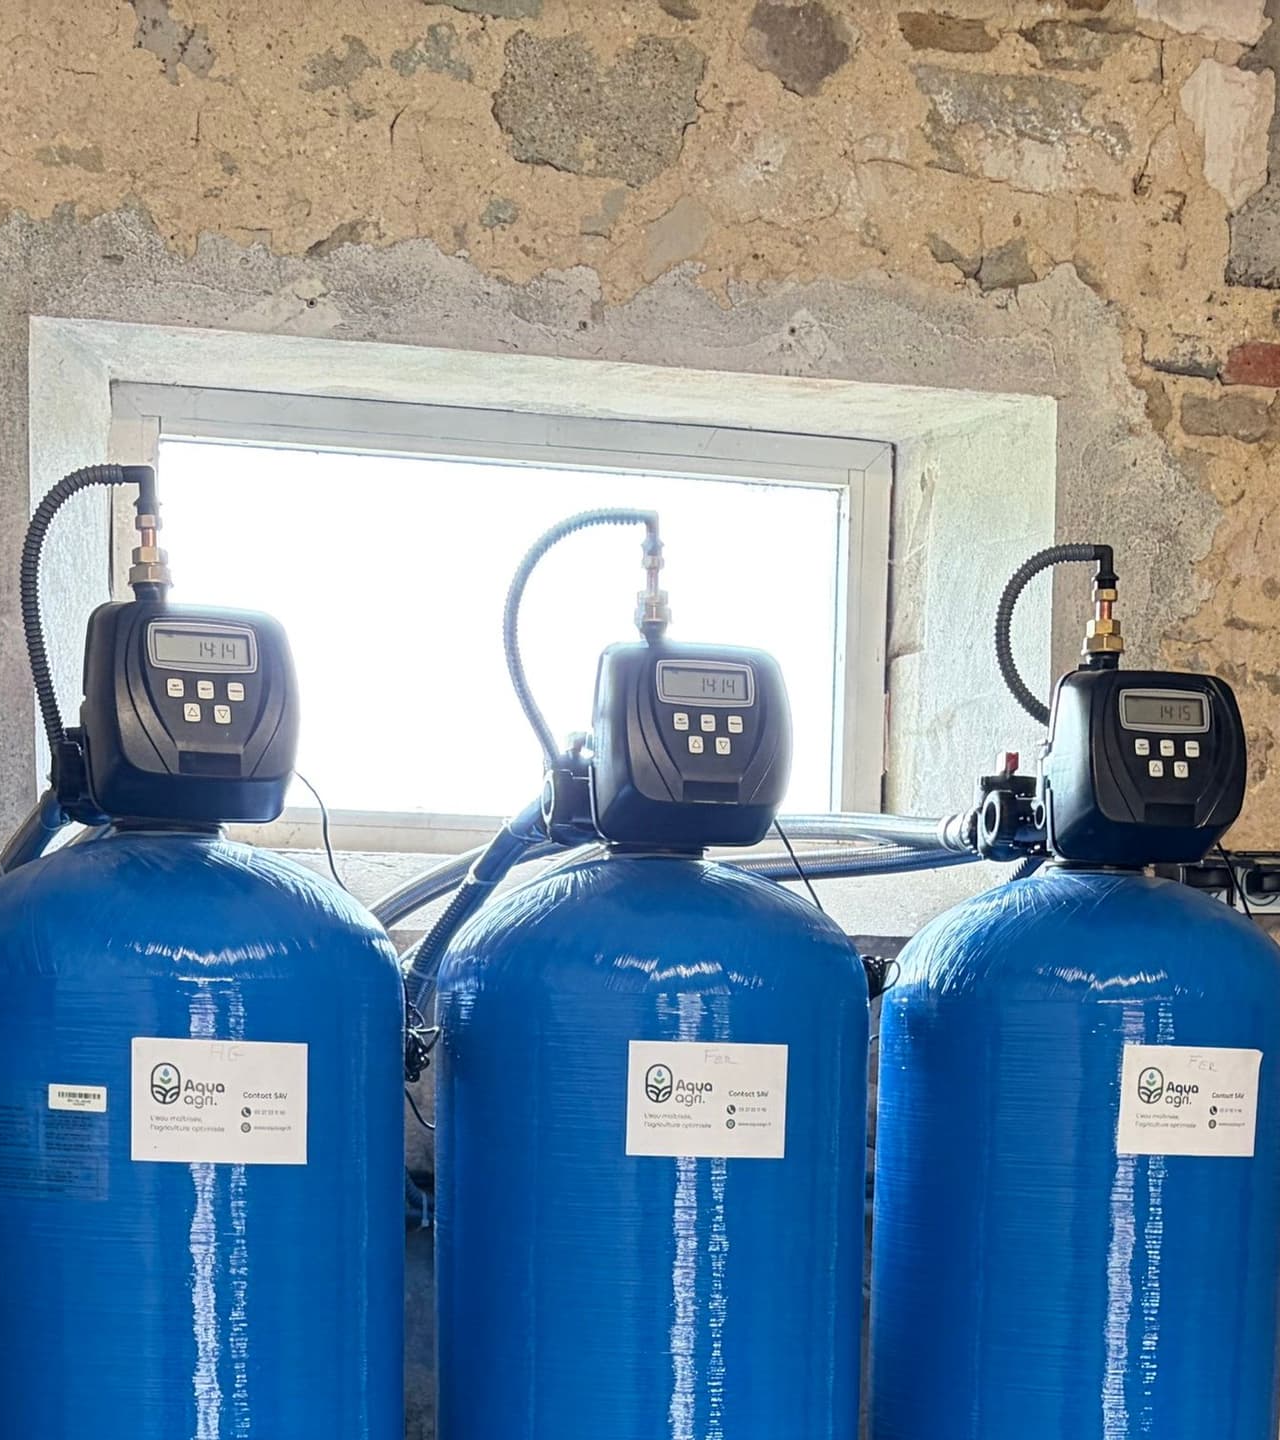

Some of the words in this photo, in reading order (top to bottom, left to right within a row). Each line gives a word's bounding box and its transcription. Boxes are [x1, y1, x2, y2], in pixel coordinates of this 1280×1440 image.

[183, 1079, 225, 1096] Aqua
[675, 1079, 713, 1094] Aqua
[728, 1090, 755, 1098] Contact
[1165, 1081, 1199, 1096] Aqua
[242, 1091, 272, 1100] Contact
[273, 1092, 288, 1100] SAV
